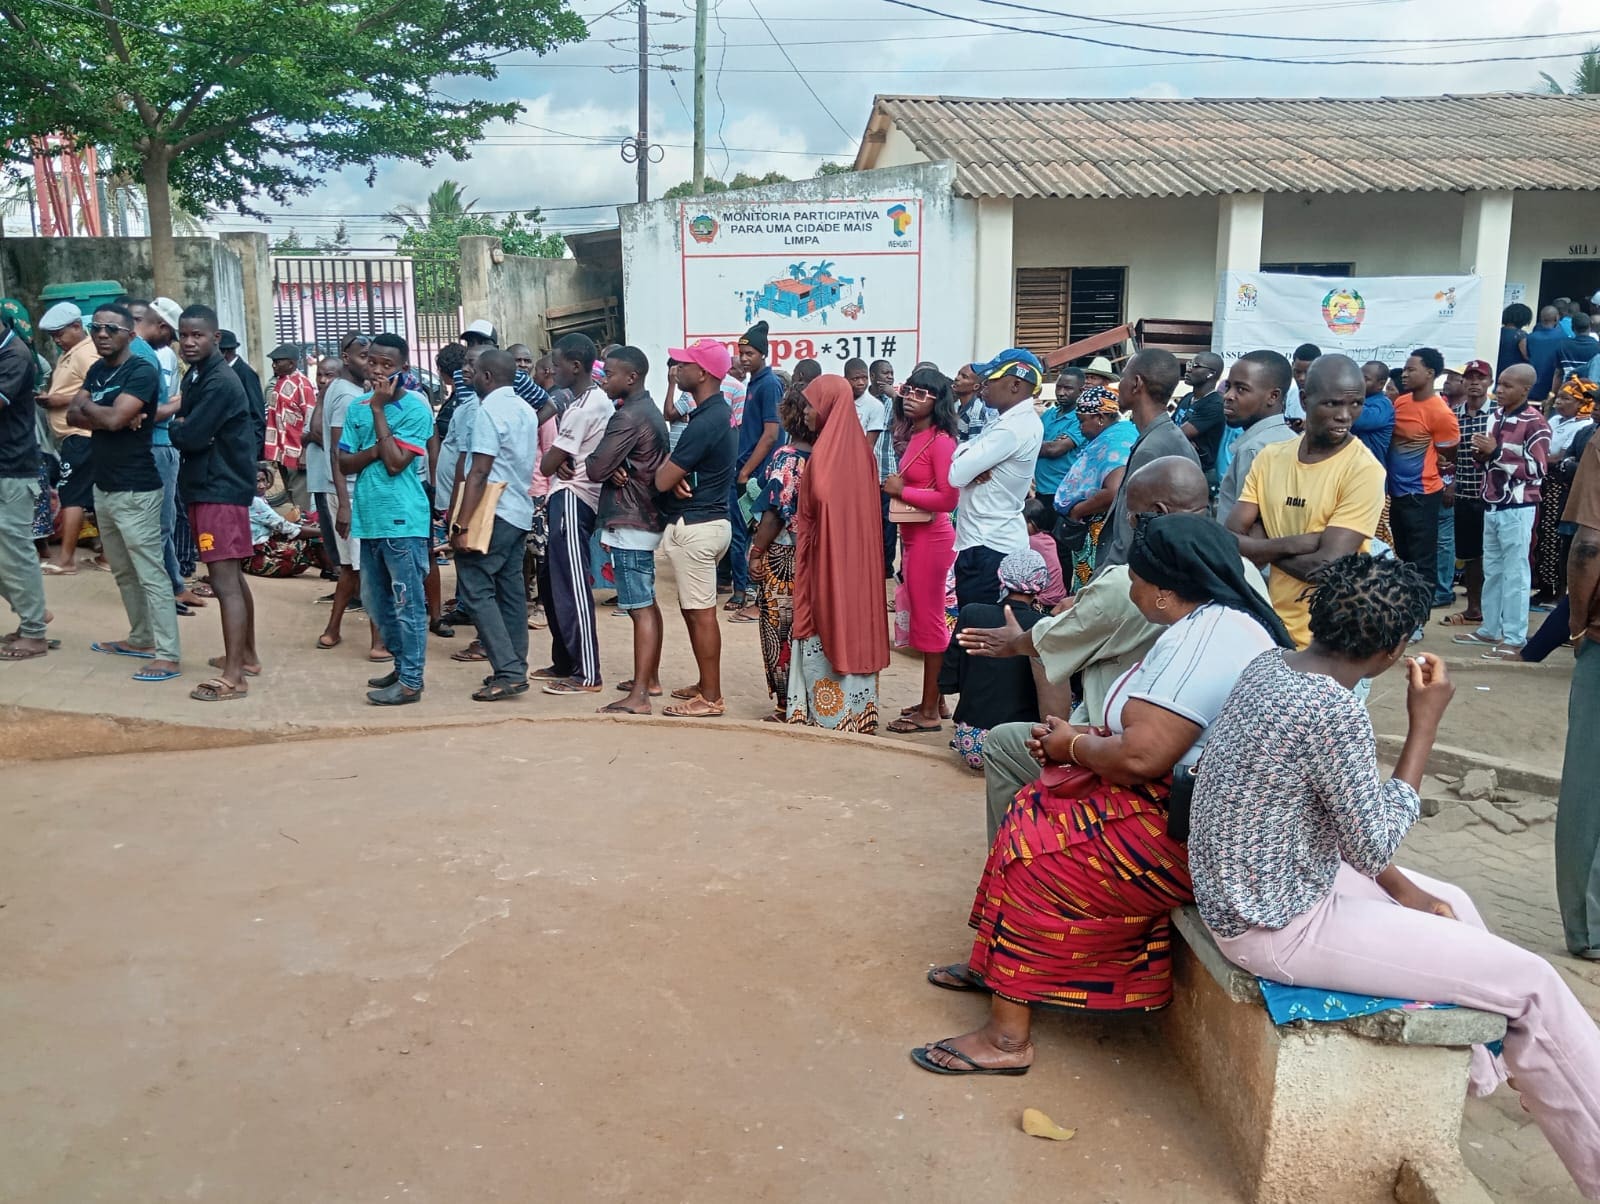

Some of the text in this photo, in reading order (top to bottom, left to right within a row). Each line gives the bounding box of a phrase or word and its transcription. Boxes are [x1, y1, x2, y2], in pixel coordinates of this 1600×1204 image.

[723, 211, 879, 221] MONITORIA PARTICIPATIVA
[731, 222, 872, 233] PARA UMA CIDADE MAIS
[784, 236, 819, 245] LIMPA
